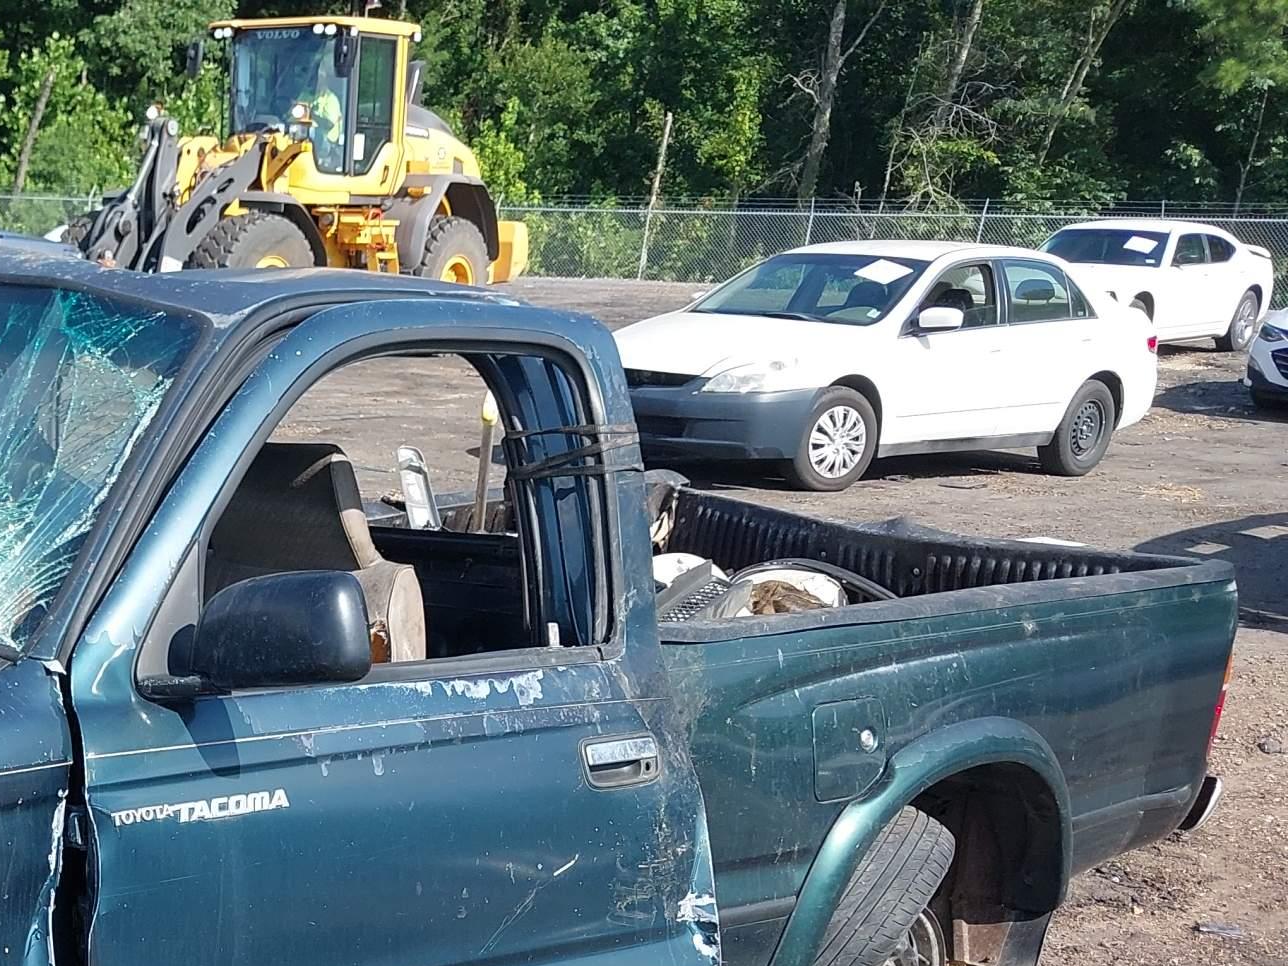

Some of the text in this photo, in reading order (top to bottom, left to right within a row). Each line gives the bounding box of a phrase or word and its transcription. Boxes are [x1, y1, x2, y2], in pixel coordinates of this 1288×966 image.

[256, 30, 300, 39] VOLVO
[111, 788, 290, 827] TOYOTA TACOMA
